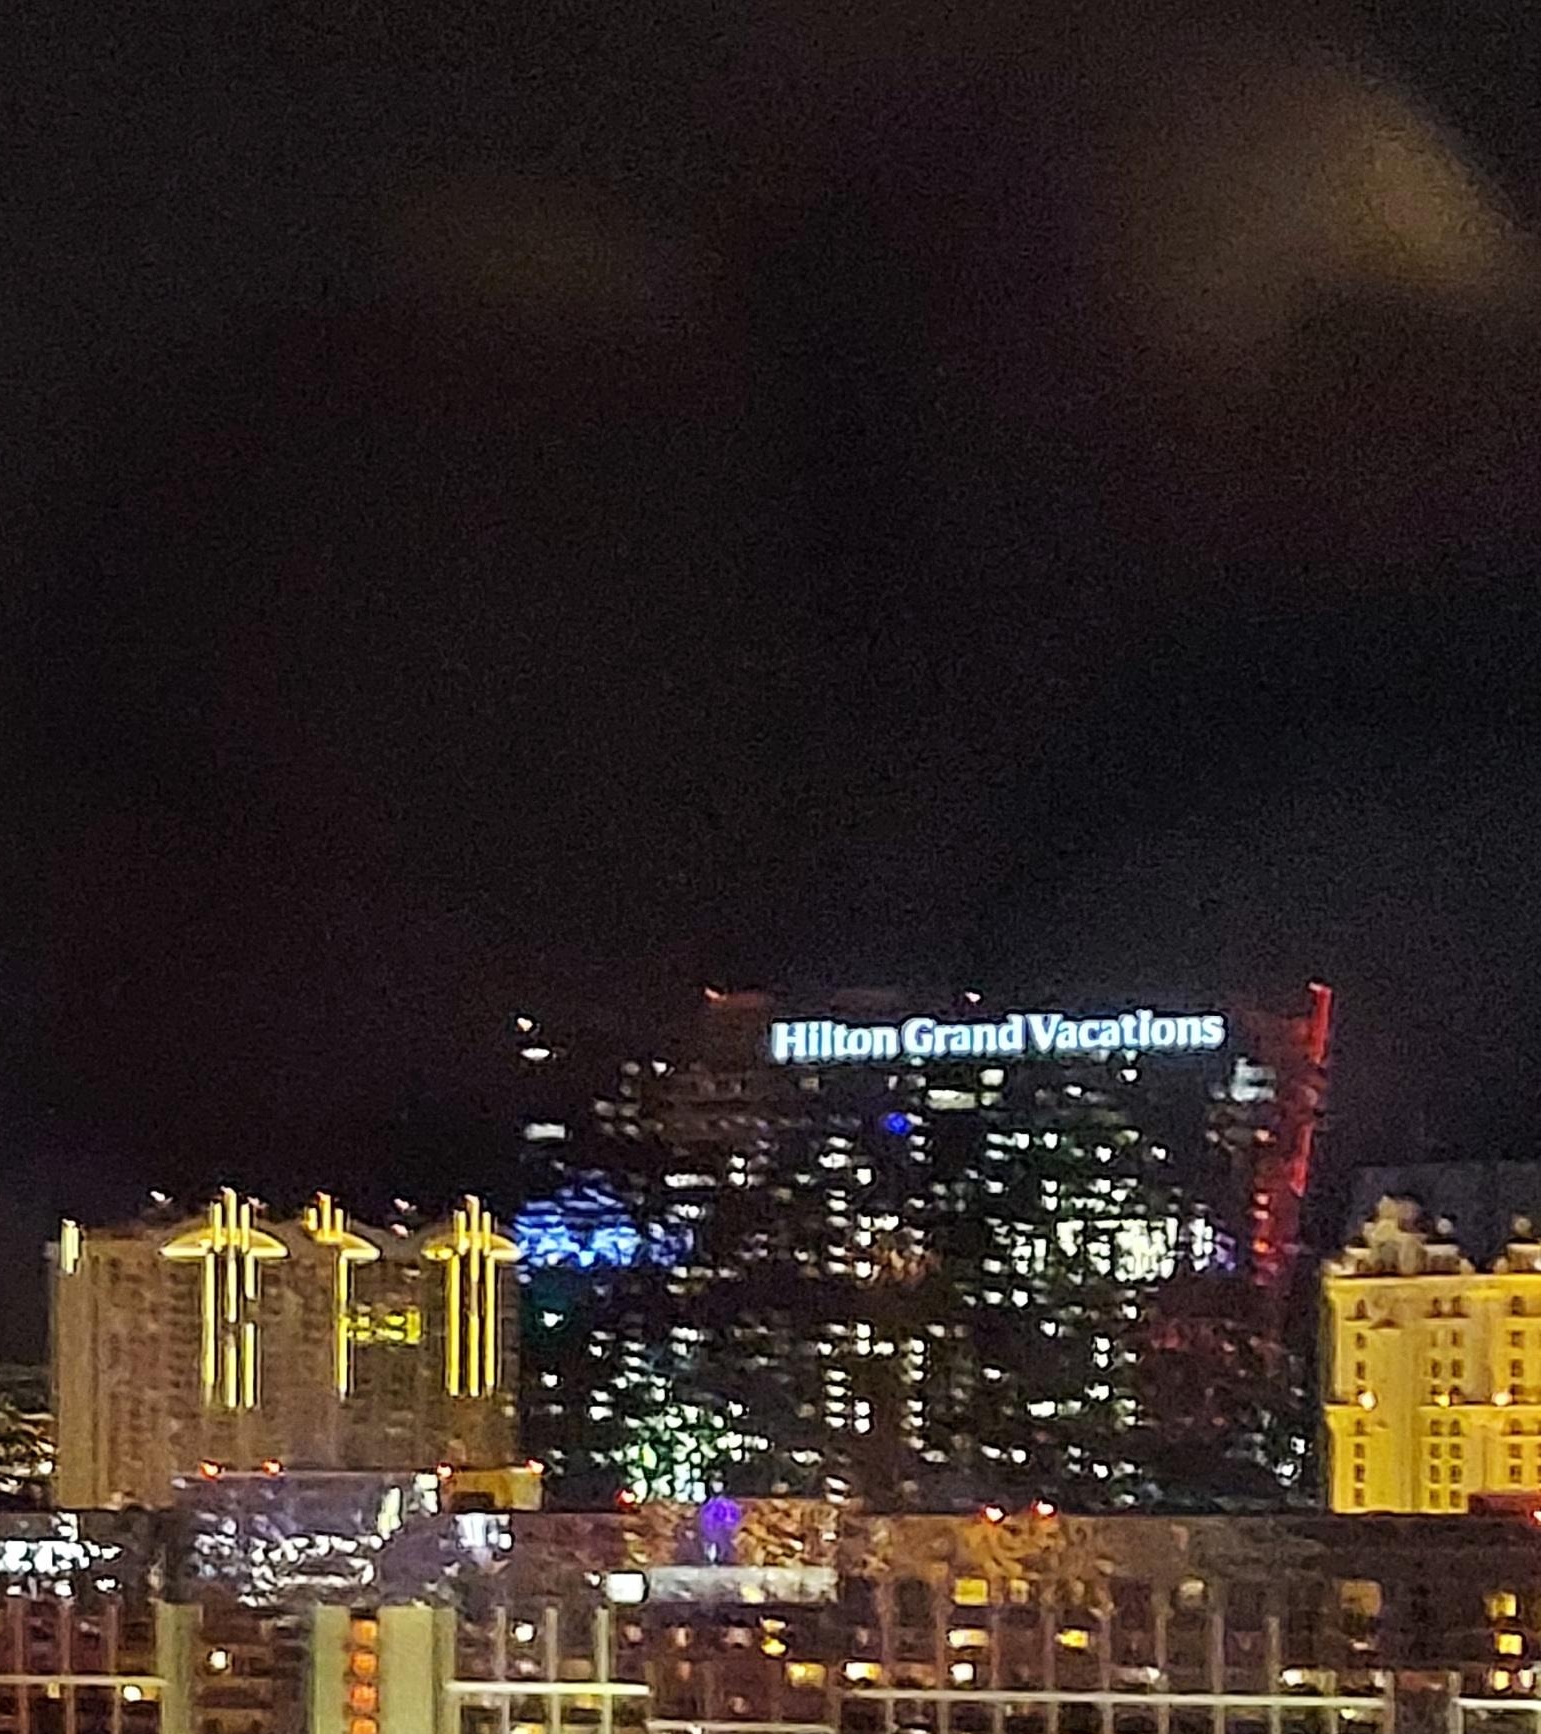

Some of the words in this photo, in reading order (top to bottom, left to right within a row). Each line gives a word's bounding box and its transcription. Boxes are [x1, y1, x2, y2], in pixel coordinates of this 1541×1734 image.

[771, 1020, 900, 1063] Hilton
[902, 1014, 1024, 1058] Grand
[1026, 1009, 1225, 1053] Vacations
